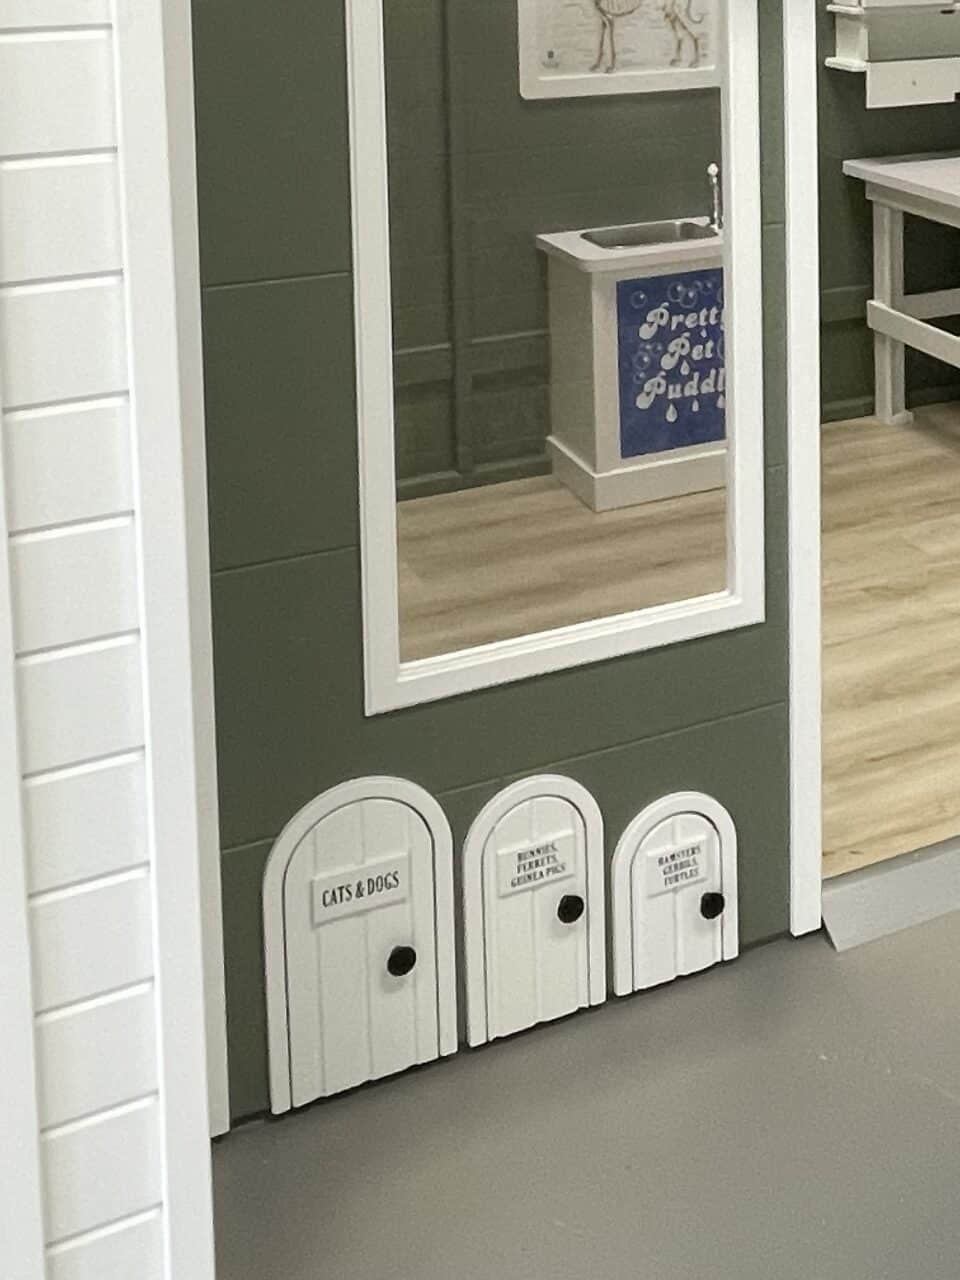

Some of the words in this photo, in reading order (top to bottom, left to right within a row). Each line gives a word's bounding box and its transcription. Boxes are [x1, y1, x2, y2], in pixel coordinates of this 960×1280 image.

[639, 302, 725, 340] Prett
[660, 331, 714, 370] Pet
[322, 883, 353, 908] CATS
[355, 880, 365, 899] &
[367, 870, 400, 896] DOGS
